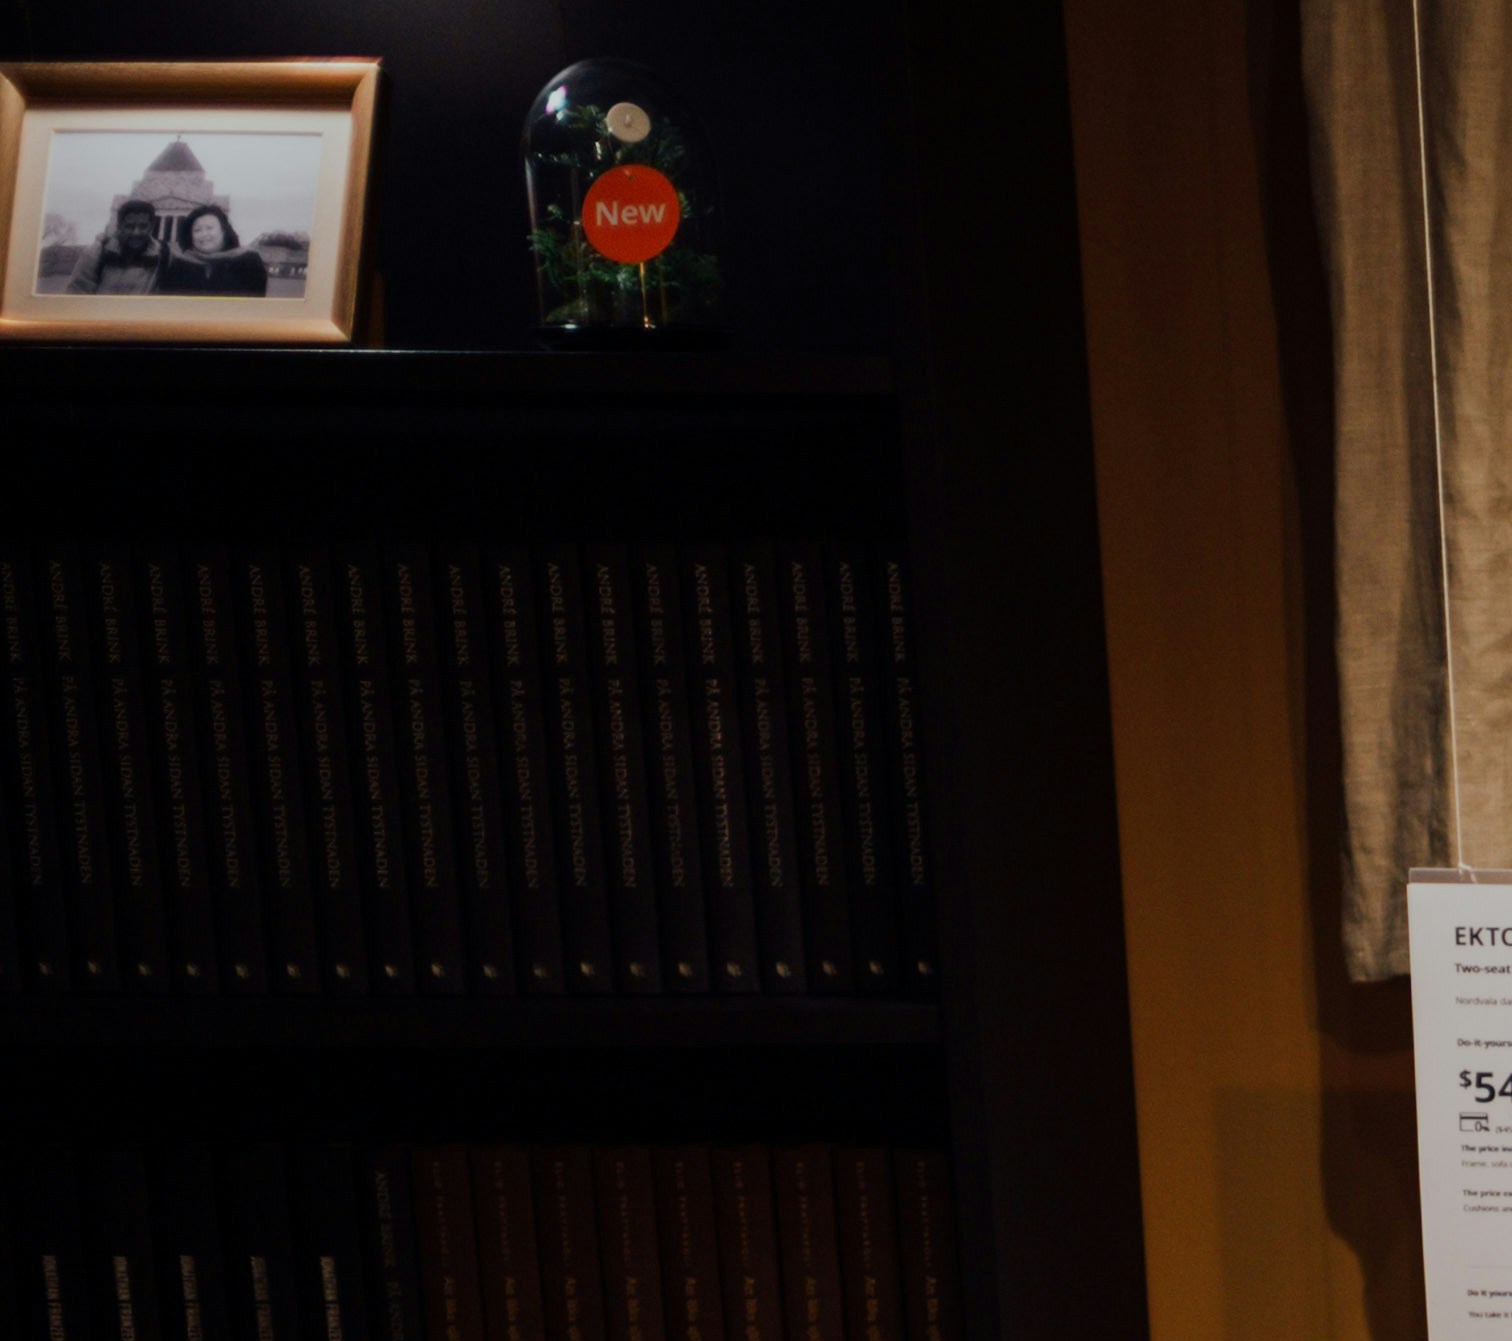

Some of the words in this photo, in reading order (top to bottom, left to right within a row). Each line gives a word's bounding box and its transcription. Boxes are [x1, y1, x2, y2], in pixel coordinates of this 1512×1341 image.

[596, 201, 666, 226] New
[743, 563, 758, 614] ANDRÉ
[748, 618, 764, 664] BRINK
[756, 700, 772, 750] ANDRA
[760, 756, 776, 799] SIDAN
[765, 804, 780, 887] TYSTNADEN
[1455, 964, 1512, 974] Two-seat
[1478, 1145, 1500, 1155] price
[1463, 1189, 1479, 1197] The
[1480, 1190, 1502, 1199] price
[1463, 1205, 1500, 1213] Cushions
